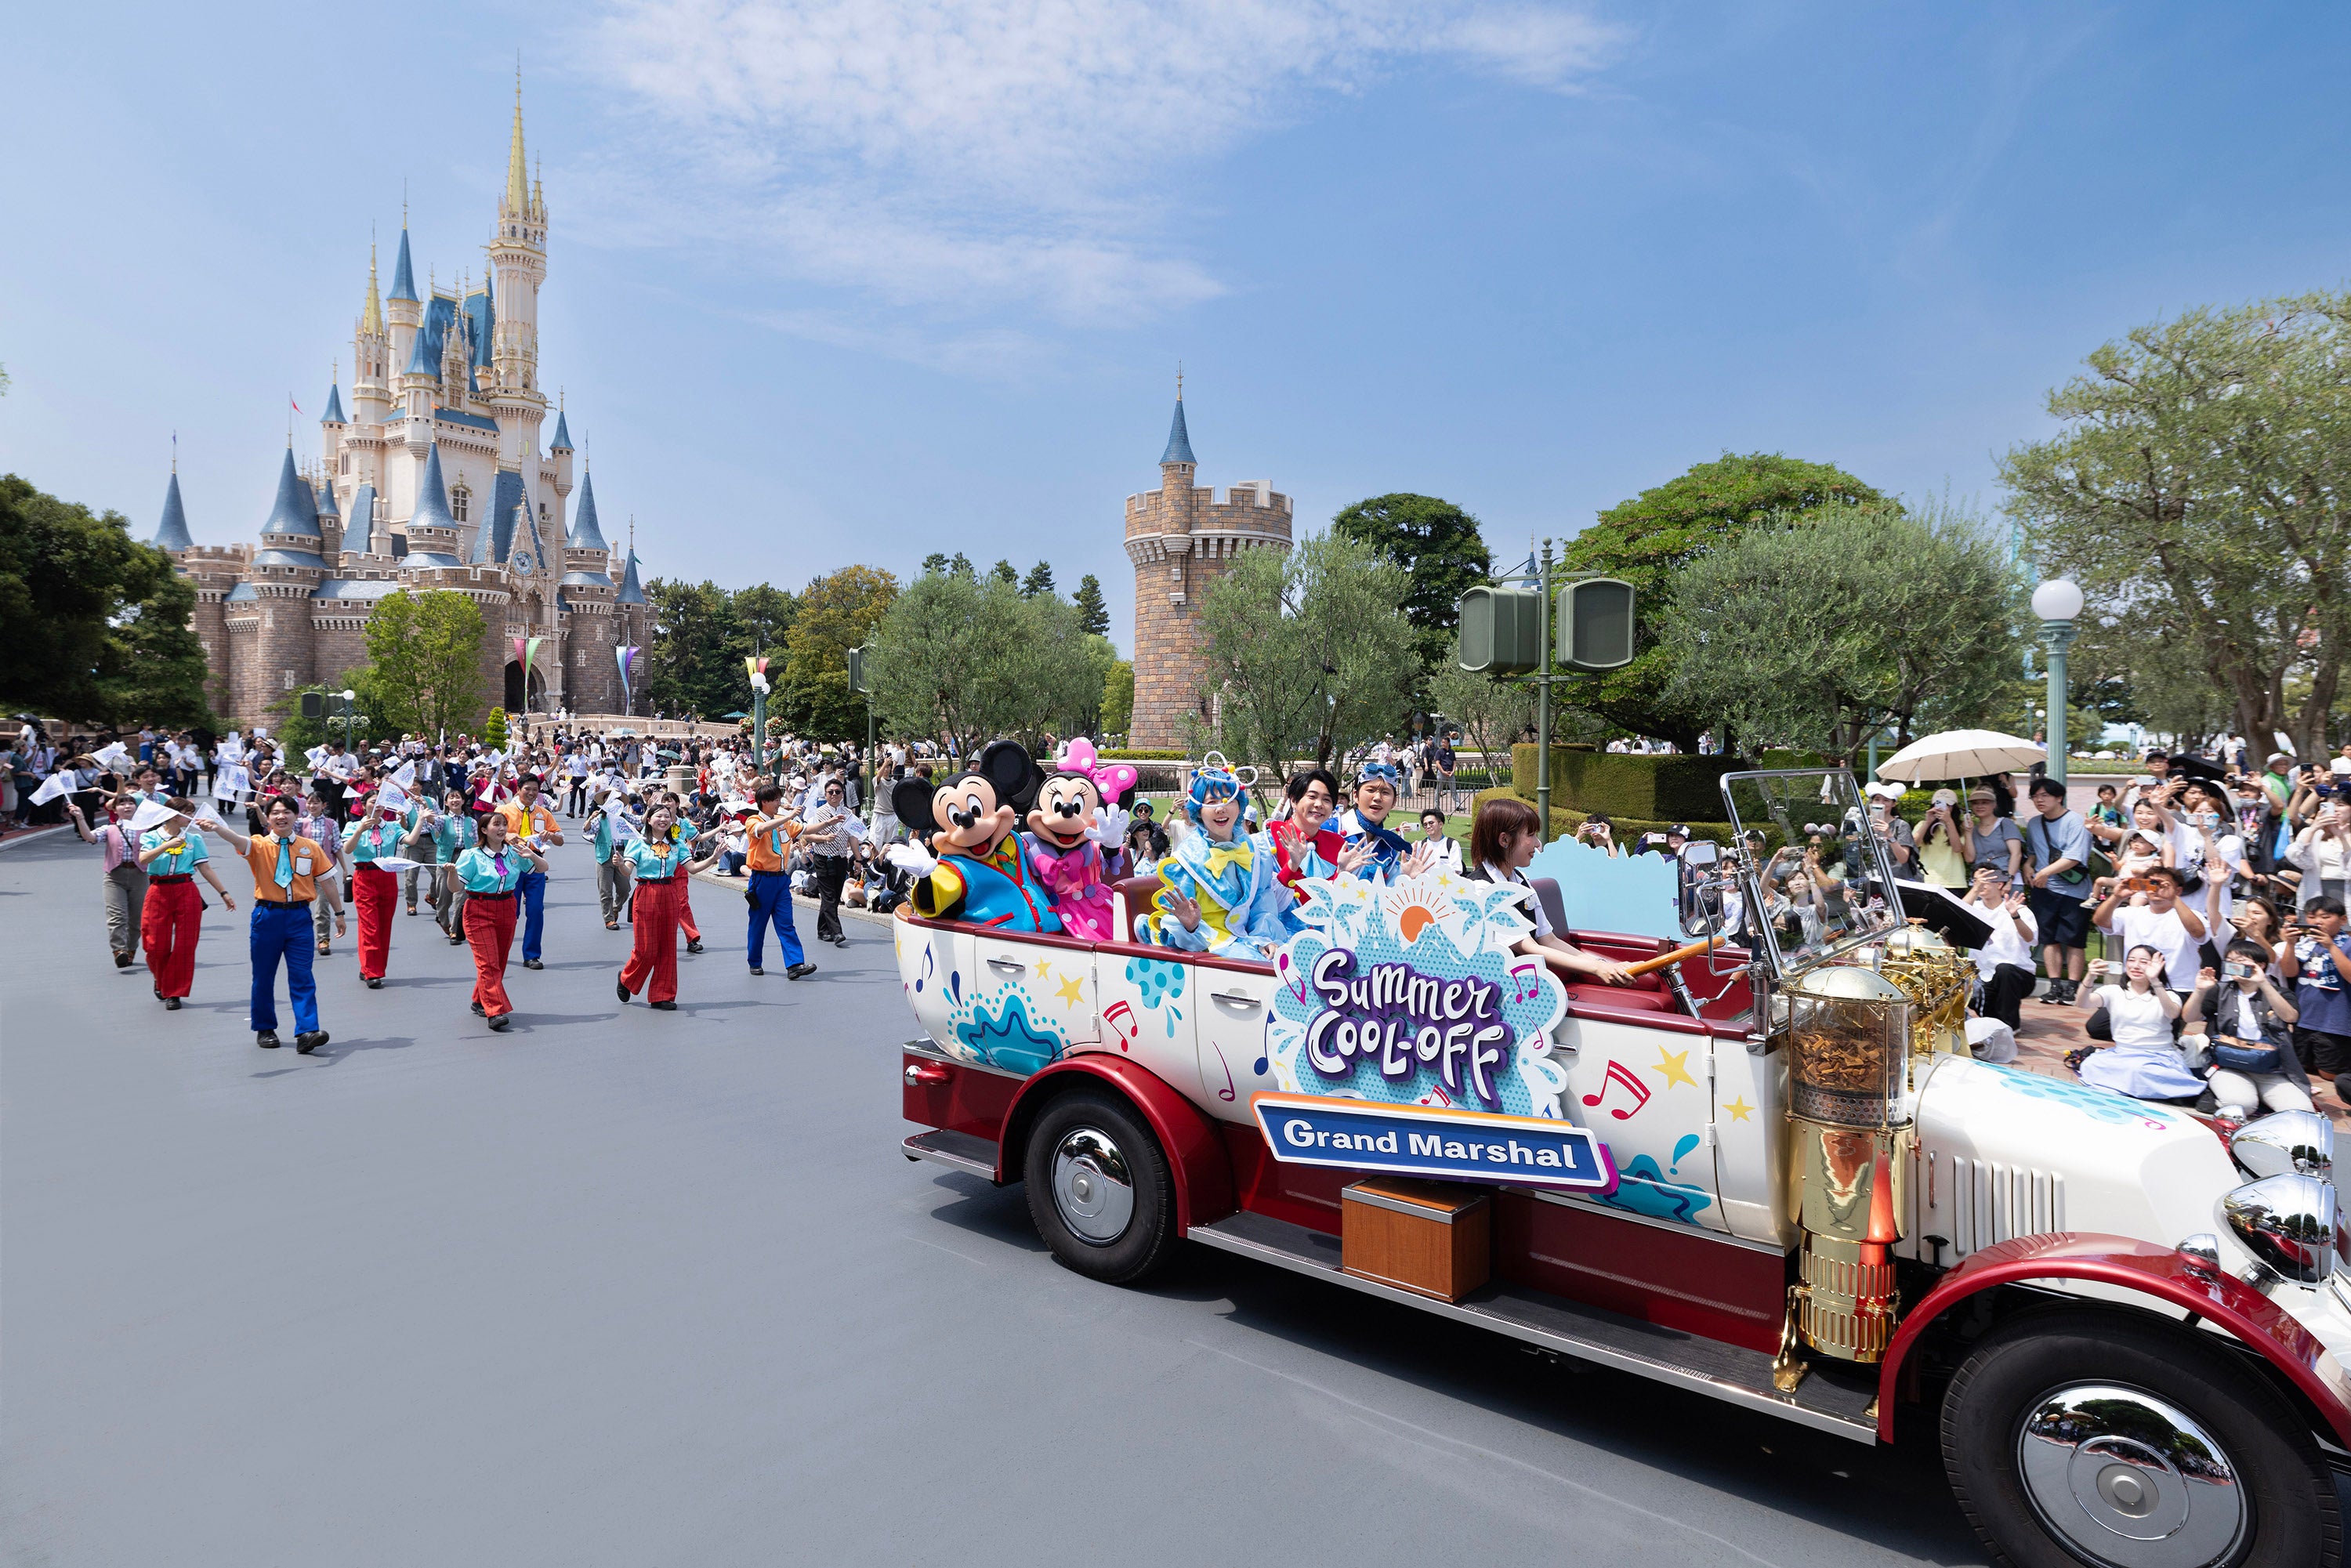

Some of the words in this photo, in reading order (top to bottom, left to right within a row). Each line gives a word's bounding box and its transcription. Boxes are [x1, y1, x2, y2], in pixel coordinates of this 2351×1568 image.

[1314, 951, 1492, 1021] Summer
[1283, 1119, 1398, 1153] Grand
[1409, 1133, 1578, 1169] Marshal
